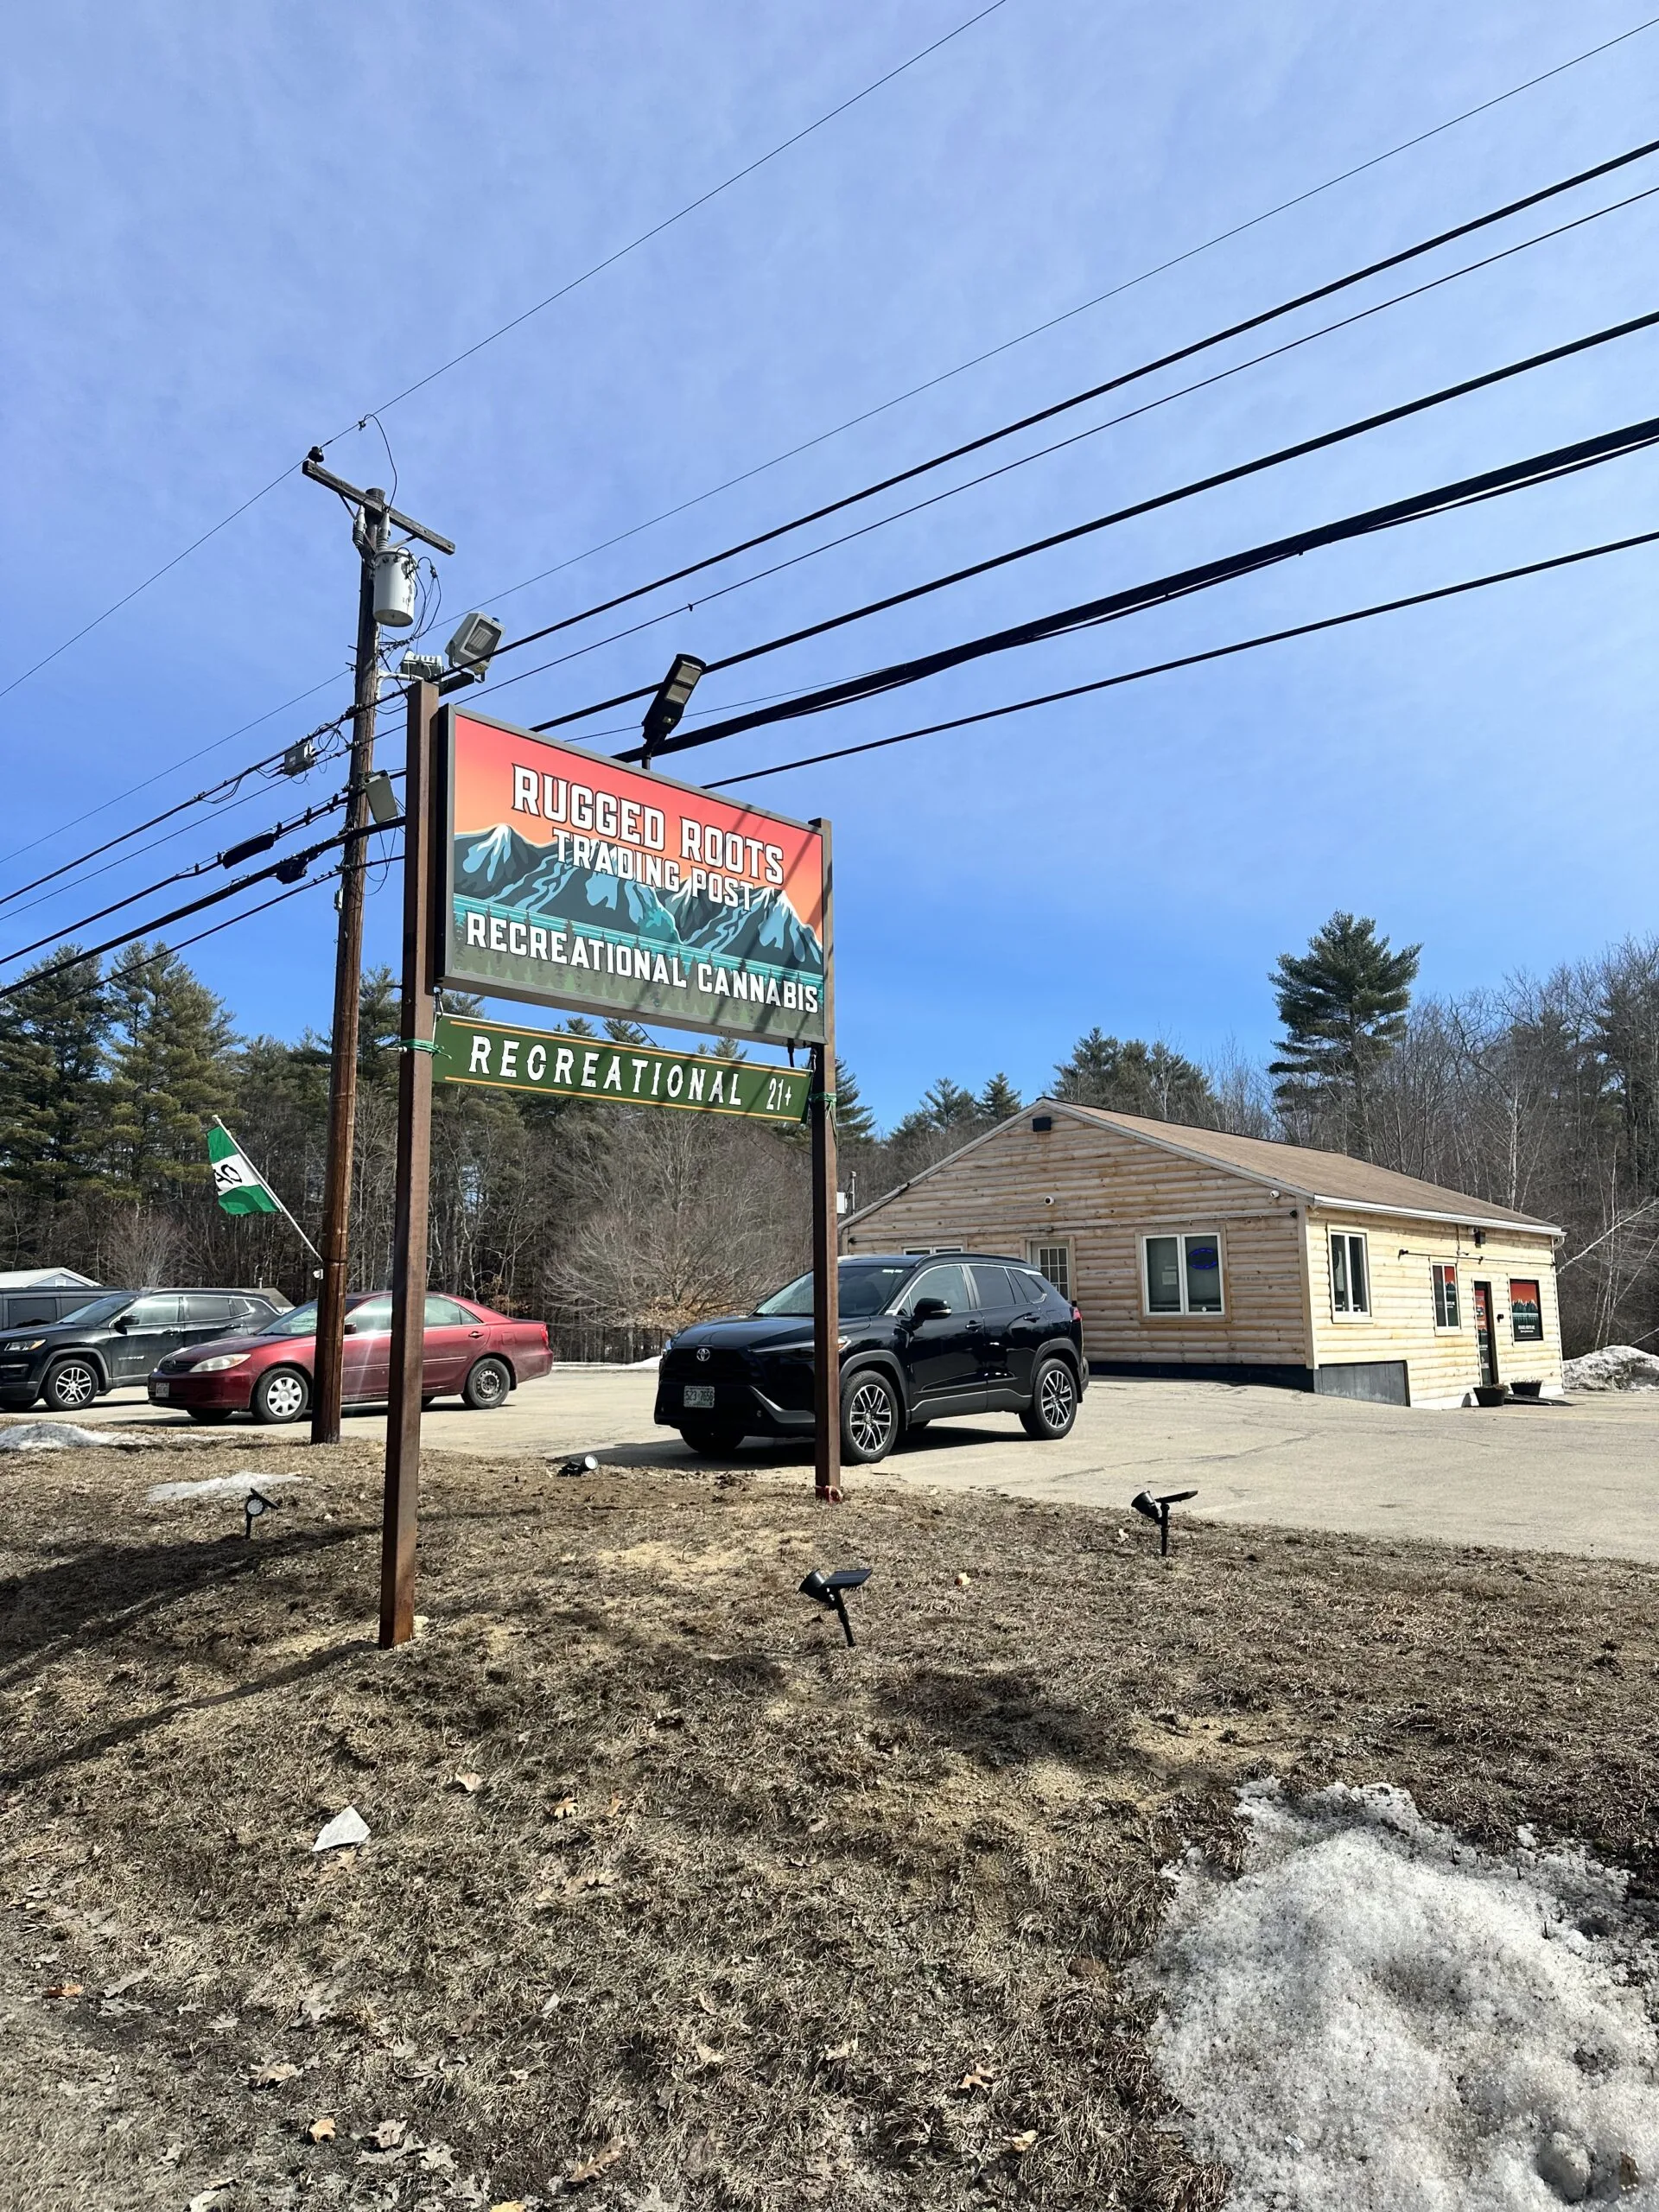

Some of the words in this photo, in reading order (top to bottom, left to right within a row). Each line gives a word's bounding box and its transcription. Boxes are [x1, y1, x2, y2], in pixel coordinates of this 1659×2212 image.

[512, 763, 665, 851] RUGGED
[679, 816, 784, 886] ROOTS
[553, 828, 681, 893] TRADING
[690, 866, 754, 912] POST
[464, 910, 688, 988] RECREATIONAL
[697, 963, 819, 1014] CANNABIS
[468, 1035, 741, 1106] RECREATIONAL
[766, 1077, 791, 1111] 21+
